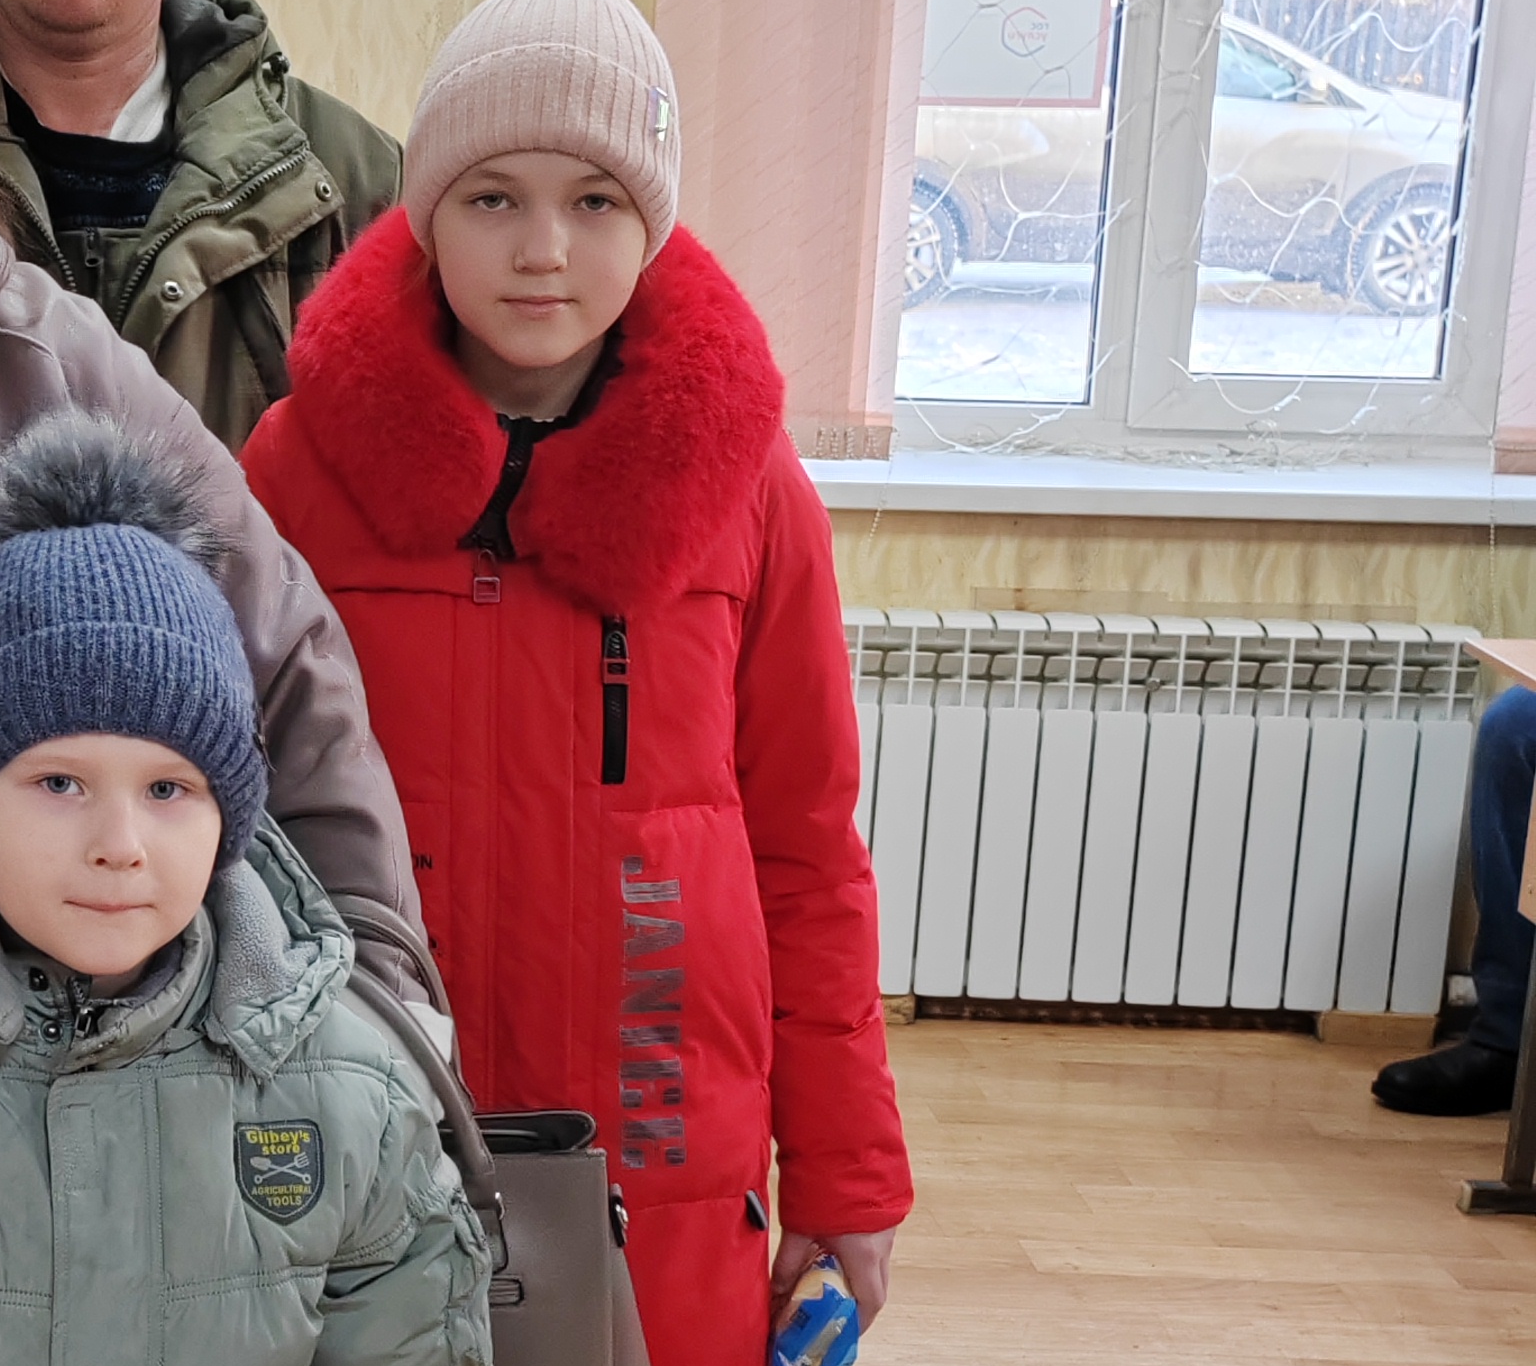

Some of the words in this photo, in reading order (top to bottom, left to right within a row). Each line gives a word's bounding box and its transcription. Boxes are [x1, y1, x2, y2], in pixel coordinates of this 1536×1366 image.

[246, 1130, 311, 1144] Gilbey's
[262, 1143, 300, 1155] store
[251, 1185, 312, 1196] AGRICULTURAL
[266, 1197, 302, 1206] TOOLS
